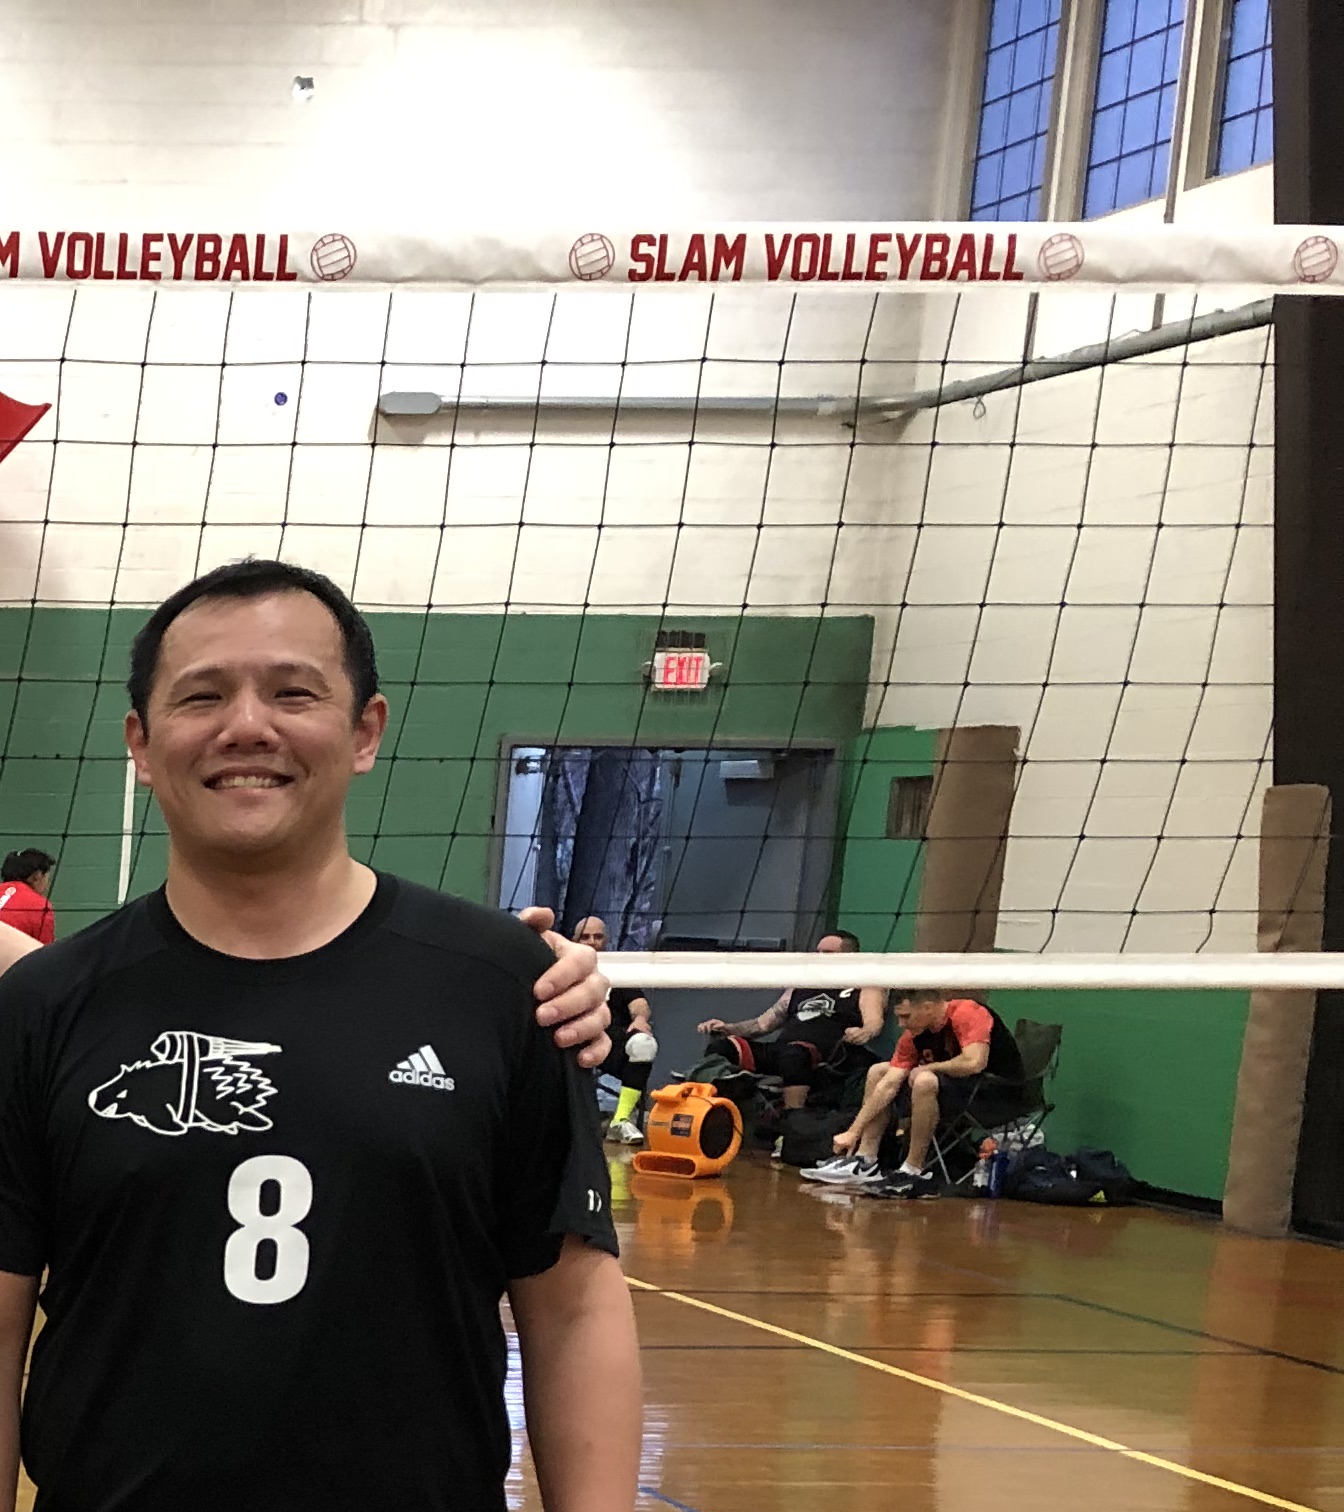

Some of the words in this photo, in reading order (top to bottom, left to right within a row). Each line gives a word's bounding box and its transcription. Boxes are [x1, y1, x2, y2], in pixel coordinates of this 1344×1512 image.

[38, 231, 297, 282] VOLLEYBALL
[628, 233, 747, 282] SLAM
[764, 233, 1023, 281] VOLLEYBALL
[663, 656, 703, 685] EXIT
[388, 1068, 455, 1091] adidas
[224, 1154, 313, 1305] 8
